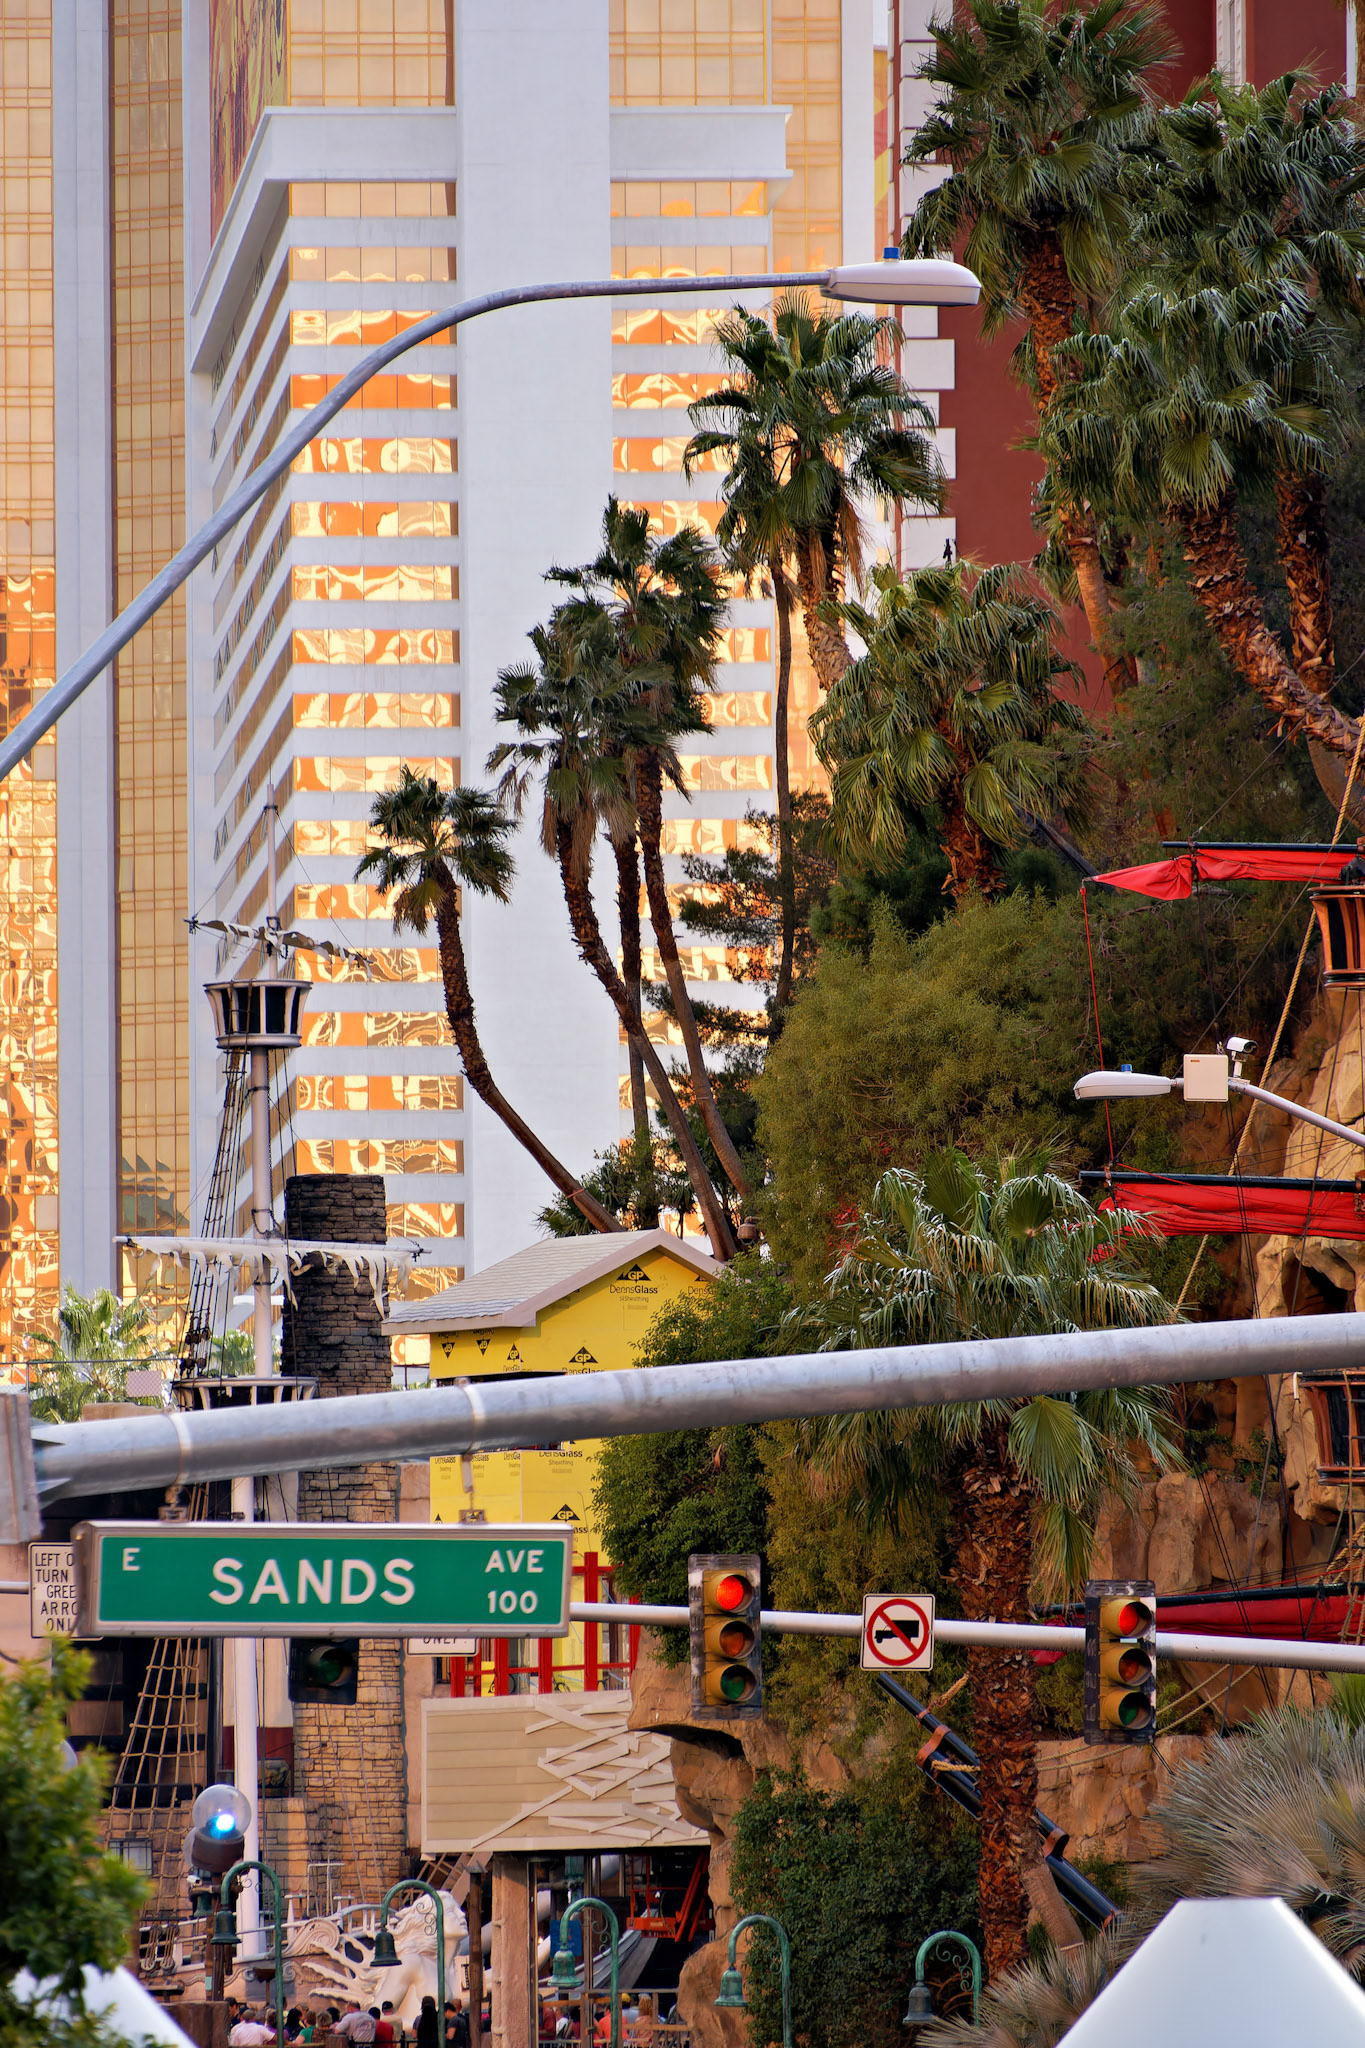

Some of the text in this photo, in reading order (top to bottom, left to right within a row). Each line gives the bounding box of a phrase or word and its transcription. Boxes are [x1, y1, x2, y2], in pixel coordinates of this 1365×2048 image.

[35, 1552, 75, 1567] LEFT O
[35, 1569, 68, 1583] TURN
[122, 1547, 544, 1606] E SANDS AVE
[46, 1585, 77, 1598] GREE
[40, 1601, 79, 1616] ARRO
[487, 1590, 539, 1615] 100
[46, 1618, 74, 1632] ONL
